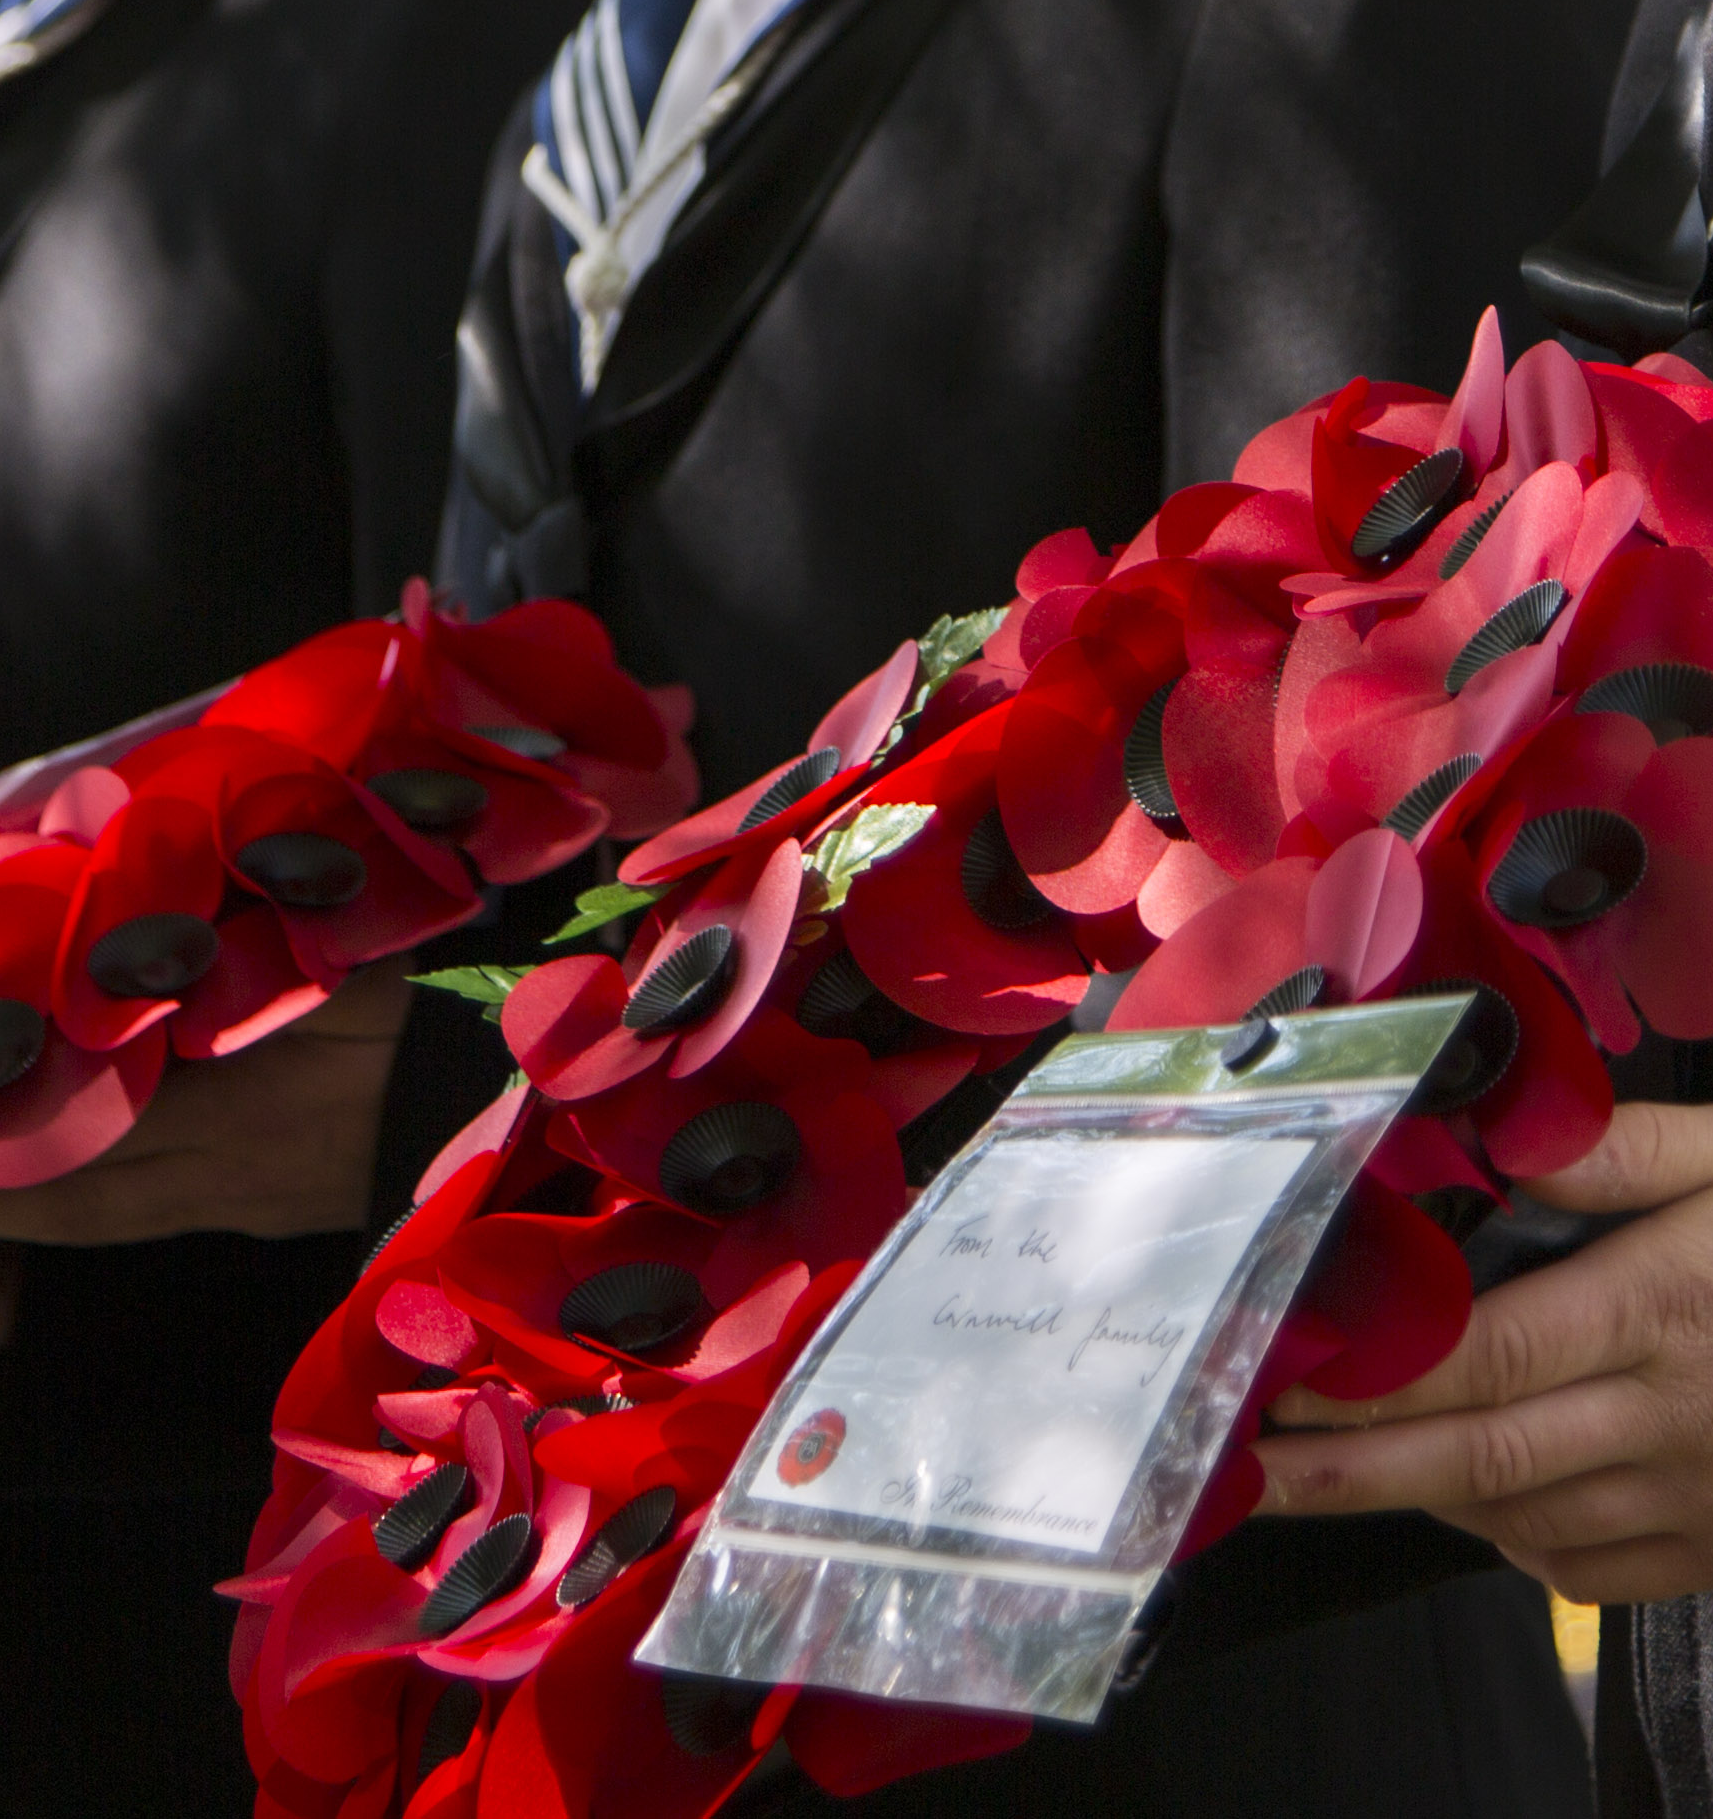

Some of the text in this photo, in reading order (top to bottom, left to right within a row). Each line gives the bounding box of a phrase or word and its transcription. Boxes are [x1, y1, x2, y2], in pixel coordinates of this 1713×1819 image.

[938, 1214, 1058, 1264] From the
[1067, 1307, 1184, 1388] family
[933, 1475, 1099, 1535] Remembrance
